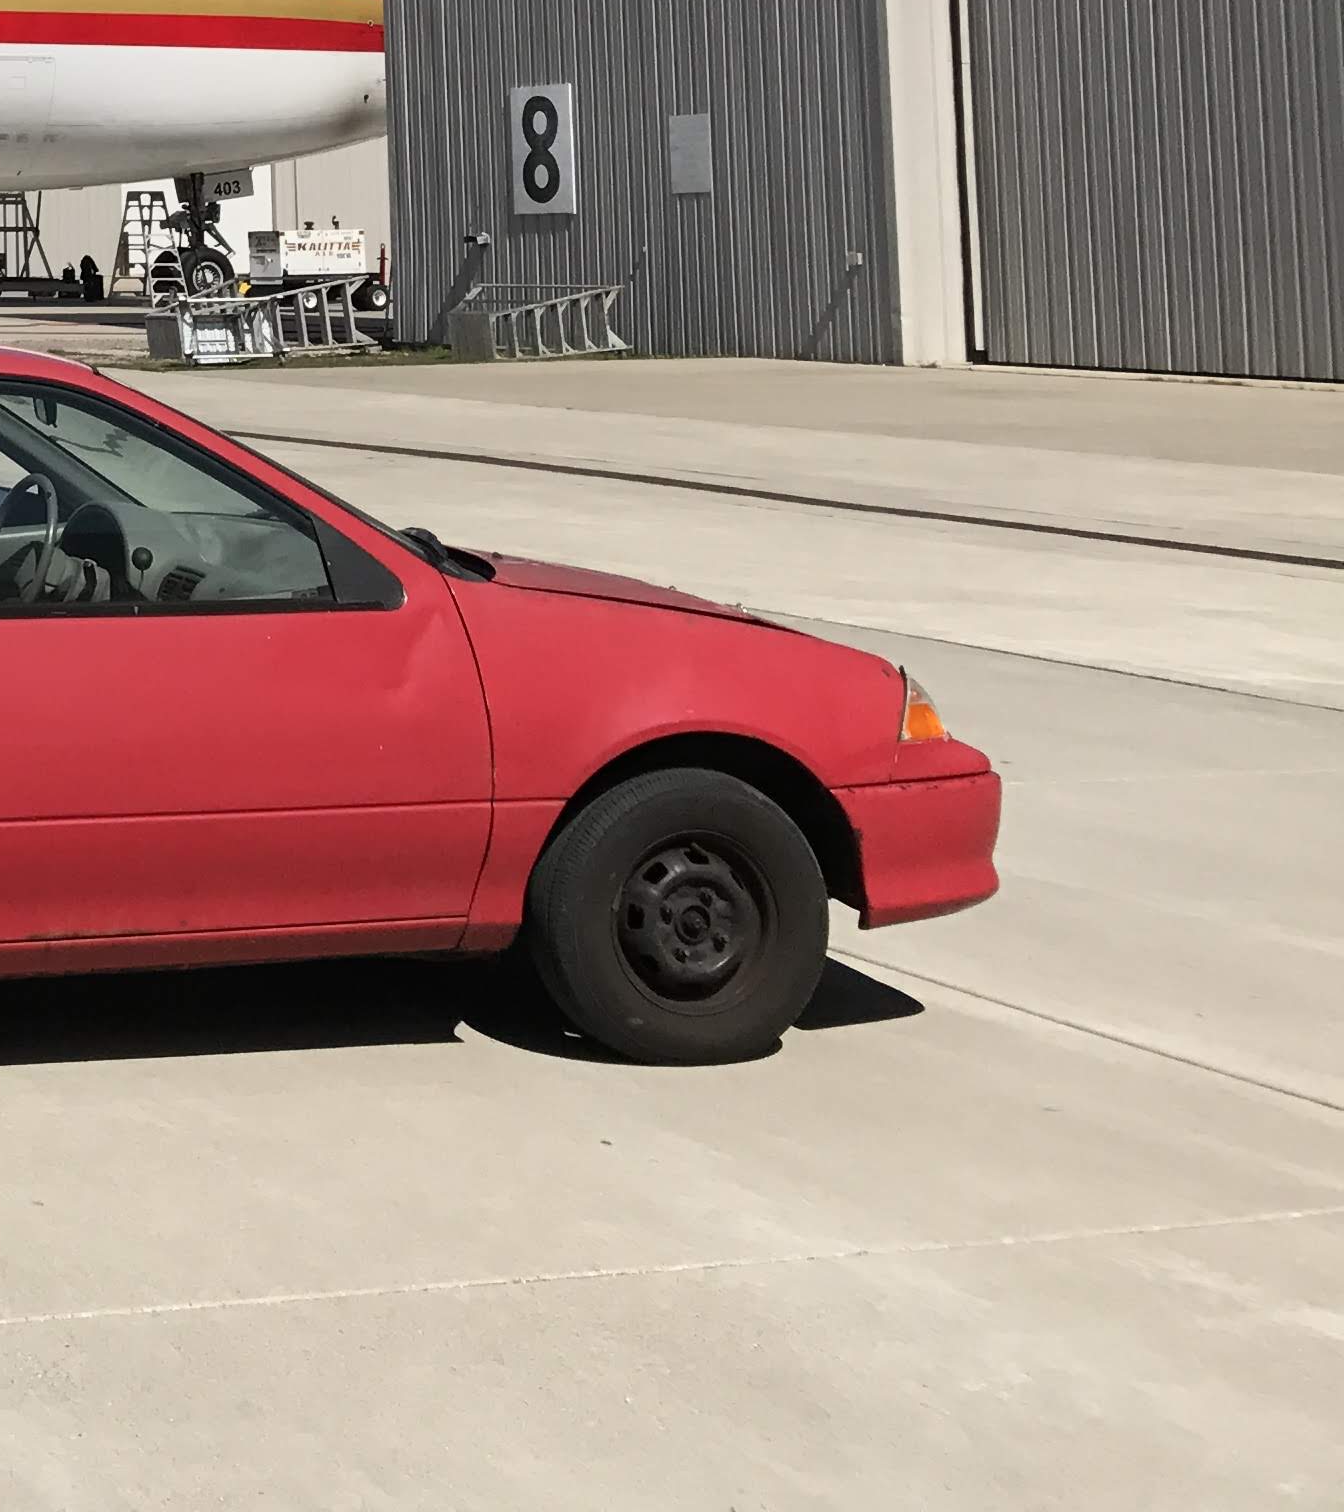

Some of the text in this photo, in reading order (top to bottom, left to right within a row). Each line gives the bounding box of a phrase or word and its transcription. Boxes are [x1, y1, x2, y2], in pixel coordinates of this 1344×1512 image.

[521, 95, 561, 204] 8
[214, 180, 242, 197] 403
[297, 242, 351, 251] KALITTA
